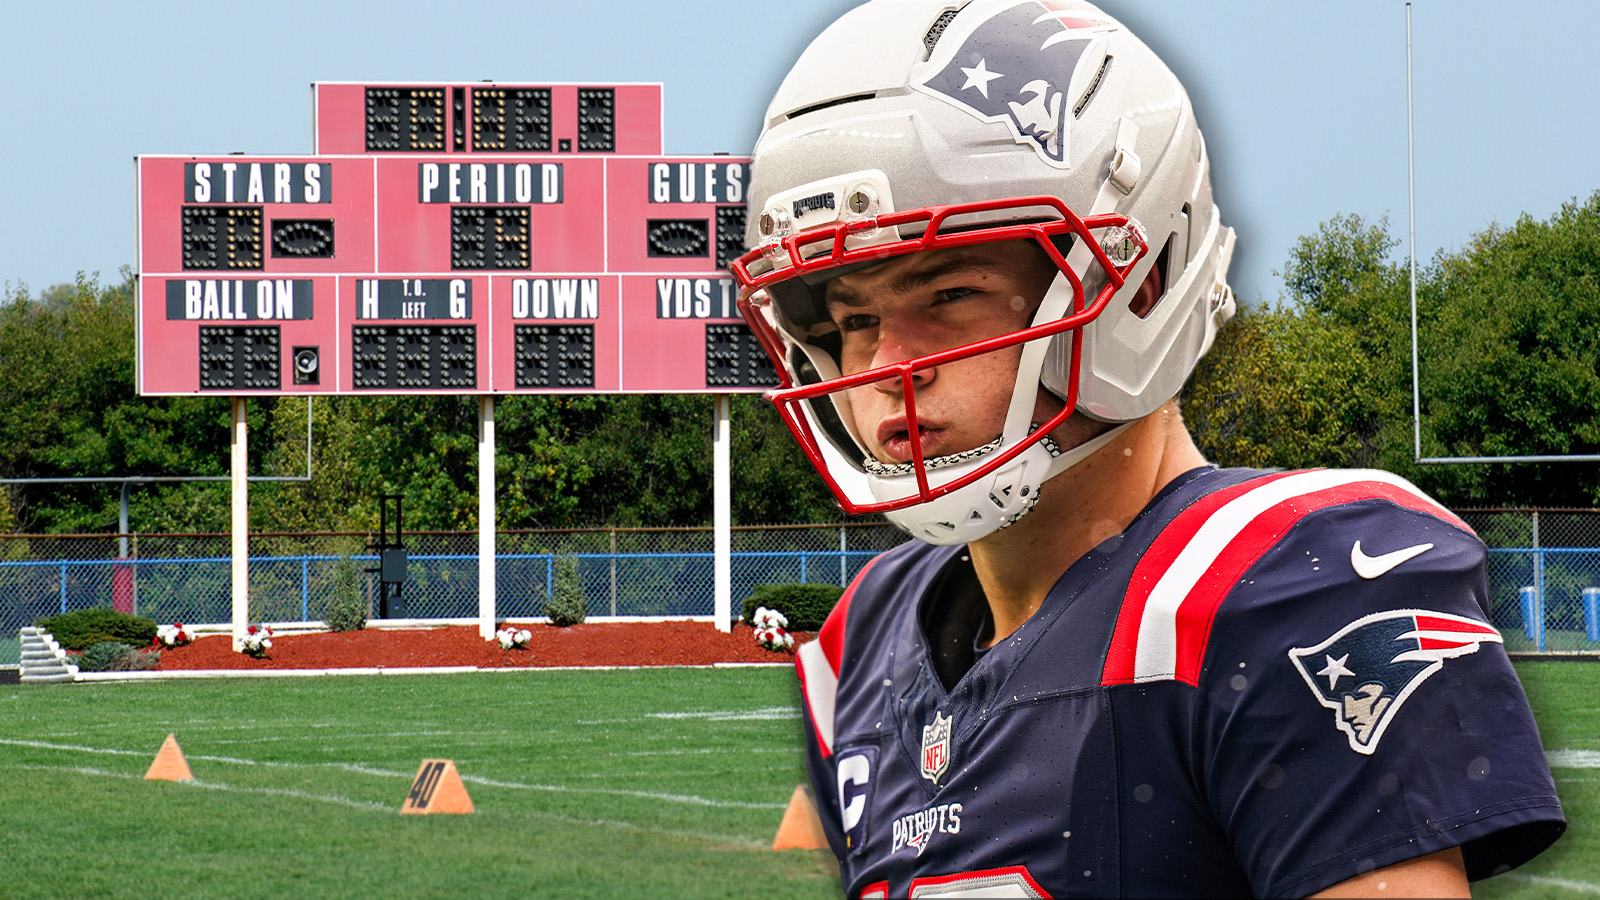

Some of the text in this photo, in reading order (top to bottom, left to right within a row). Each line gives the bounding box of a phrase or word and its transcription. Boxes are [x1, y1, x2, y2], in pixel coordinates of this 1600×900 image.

[194, 163, 321, 203] STARS
[422, 163, 559, 203] PERIOD
[653, 163, 753, 203] GUES
[185, 279, 294, 319] BALL ON
[362, 280, 379, 319] H
[402, 279, 426, 296] T.O.
[449, 279, 466, 319] G
[513, 279, 599, 319] DOWN
[658, 279, 711, 319] YDS
[402, 302, 426, 319] LEFT
[925, 745, 946, 771] NFL
[408, 762, 446, 808] 40
[837, 754, 870, 834] C
[891, 803, 963, 855] PATRIOTS
